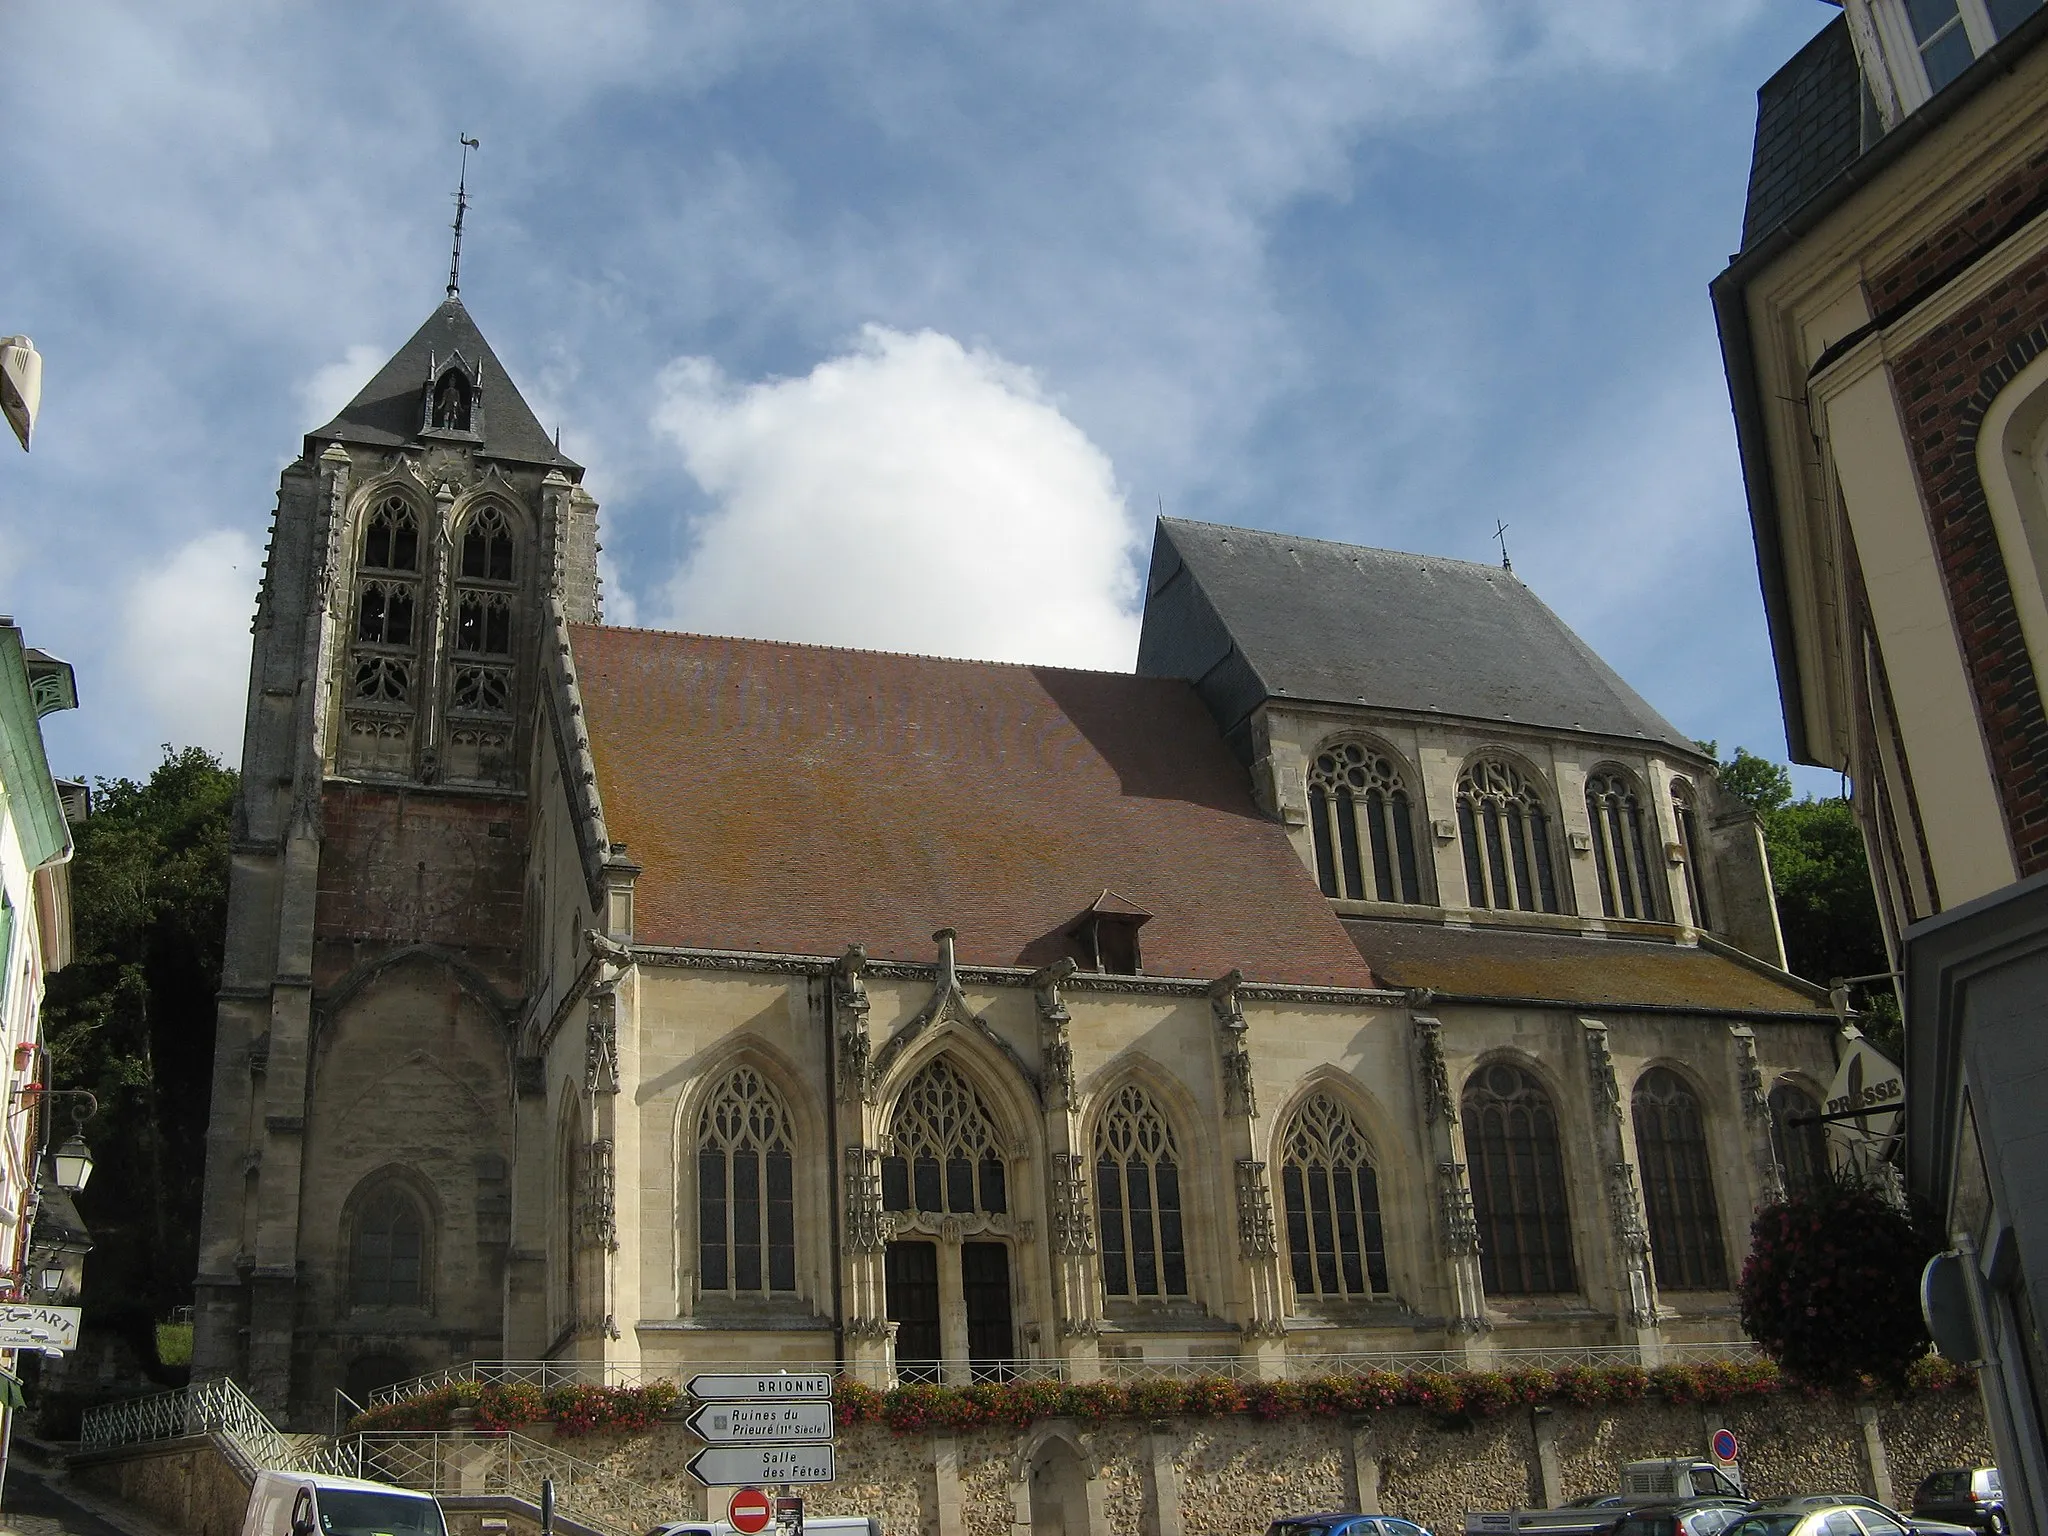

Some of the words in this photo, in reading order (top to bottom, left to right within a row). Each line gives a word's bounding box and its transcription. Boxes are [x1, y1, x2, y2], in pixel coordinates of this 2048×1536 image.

[758, 1381, 824, 1392] BRIONNE
[732, 1409, 776, 1421] Ruines
[784, 1409, 798, 1420] du
[732, 1424, 773, 1435] Prieuré
[794, 1422, 826, 1434] Siècle)
[762, 1452, 796, 1463] Salle
[763, 1467, 784, 1478] des
[792, 1465, 827, 1477] Fêtes
